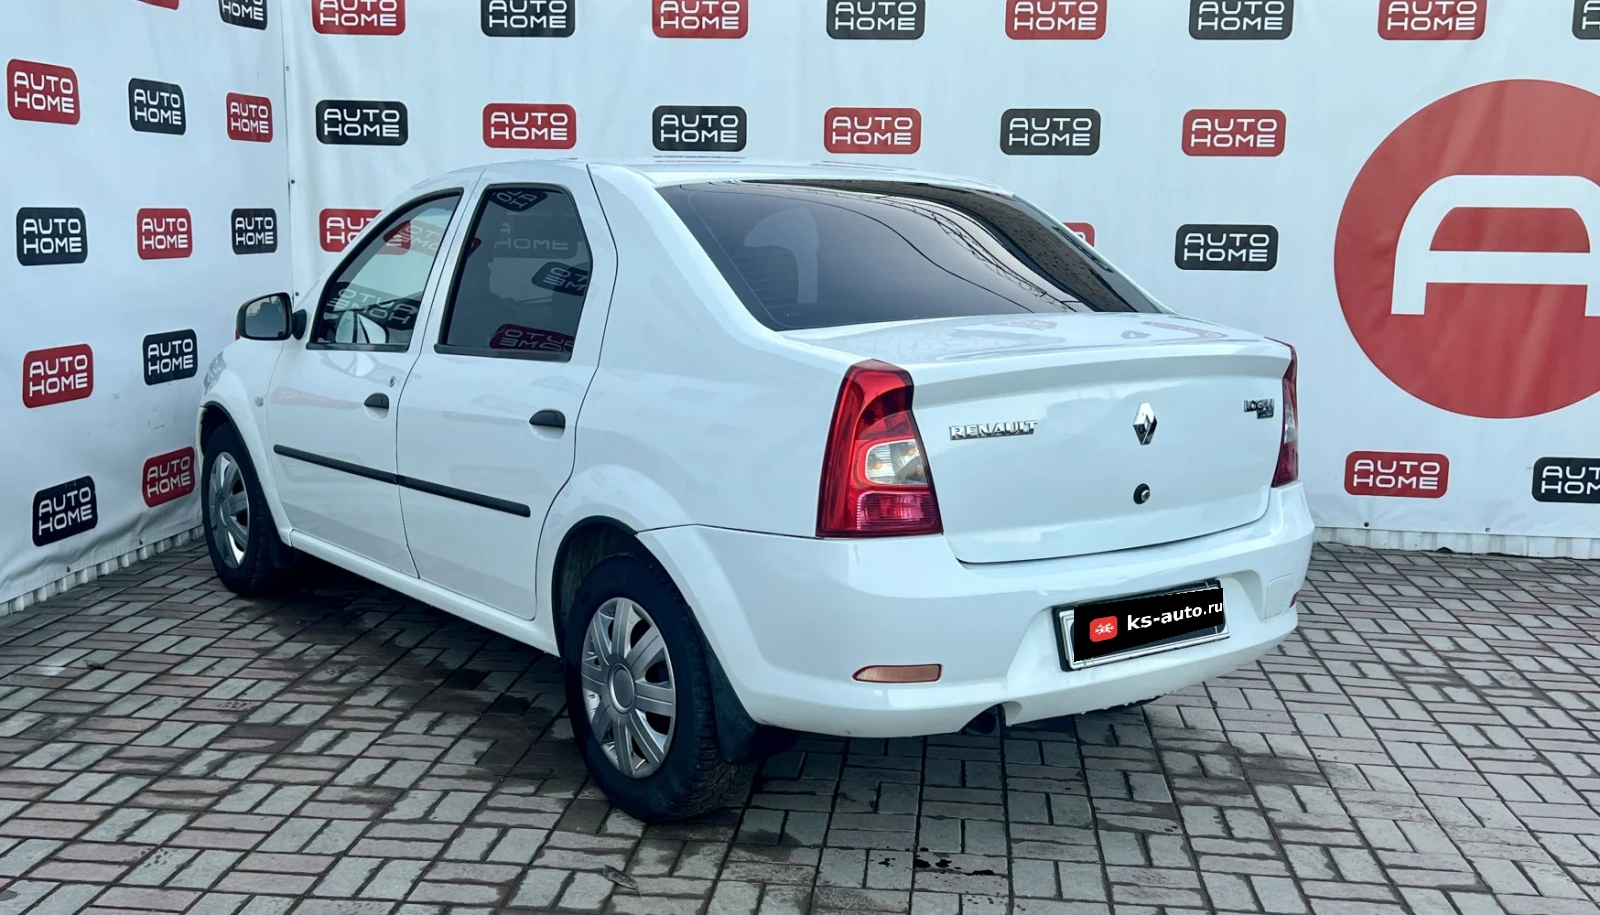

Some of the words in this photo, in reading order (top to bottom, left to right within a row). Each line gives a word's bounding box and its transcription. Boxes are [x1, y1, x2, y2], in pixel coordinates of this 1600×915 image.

[222, 0, 263, 21] HOME
[320, 0, 397, 11] AUTO
[489, 0, 567, 13] AUTO
[661, 1, 740, 14] AUTO
[836, 2, 916, 15] AUTO
[1015, 1, 1098, 14] AUTO
[1199, 1, 1284, 14] AUTO
[1388, 1, 1477, 14] AUTO
[320, 13, 396, 26] HOME
[489, 15, 566, 28] HOME
[661, 16, 739, 29] HOME
[835, 17, 915, 30] HOME
[1014, 17, 1096, 30] HOME
[1198, 17, 1283, 30] HOME
[1387, 17, 1475, 30] HOME
[14, 72, 73, 94] AUTO
[15, 91, 74, 113] HOME
[134, 89, 180, 108] AUTO
[135, 106, 181, 125] HOME
[231, 102, 268, 118] AUTO
[324, 109, 399, 122] AUTO
[491, 112, 568, 125] AUTO
[661, 115, 738, 127] AUTO
[833, 117, 913, 129] AUTO
[1010, 118, 1092, 130] AUTO
[1192, 119, 1277, 131] AUTO
[231, 118, 268, 133] HOME
[324, 123, 399, 137] HOME
[491, 127, 567, 140] HOME
[661, 130, 737, 142] HOME
[832, 132, 911, 145] HOME
[1009, 133, 1090, 146] HOME
[1191, 134, 1275, 147] HOME
[23, 219, 81, 234] AUTO
[142, 218, 187, 232] AUTO
[236, 217, 273, 230] AUTO
[326, 217, 373, 229] AU
[143, 235, 188, 249] HOME
[236, 232, 273, 245] HOME
[1185, 233, 1269, 246] AUTO
[24, 237, 81, 254] HOME
[1184, 248, 1267, 262] HOME
[148, 339, 193, 358] AUTO
[30, 355, 87, 377] AUTO
[149, 355, 193, 375] HOME
[30, 373, 87, 396] HOME
[949, 420, 1037, 440] RENAULT
[147, 456, 190, 480] AUTO
[1355, 460, 1440, 474] AUTO
[147, 472, 190, 498] HOME
[1354, 475, 1438, 489] HOME
[40, 487, 90, 516] AUTO
[39, 505, 92, 535] HOME
